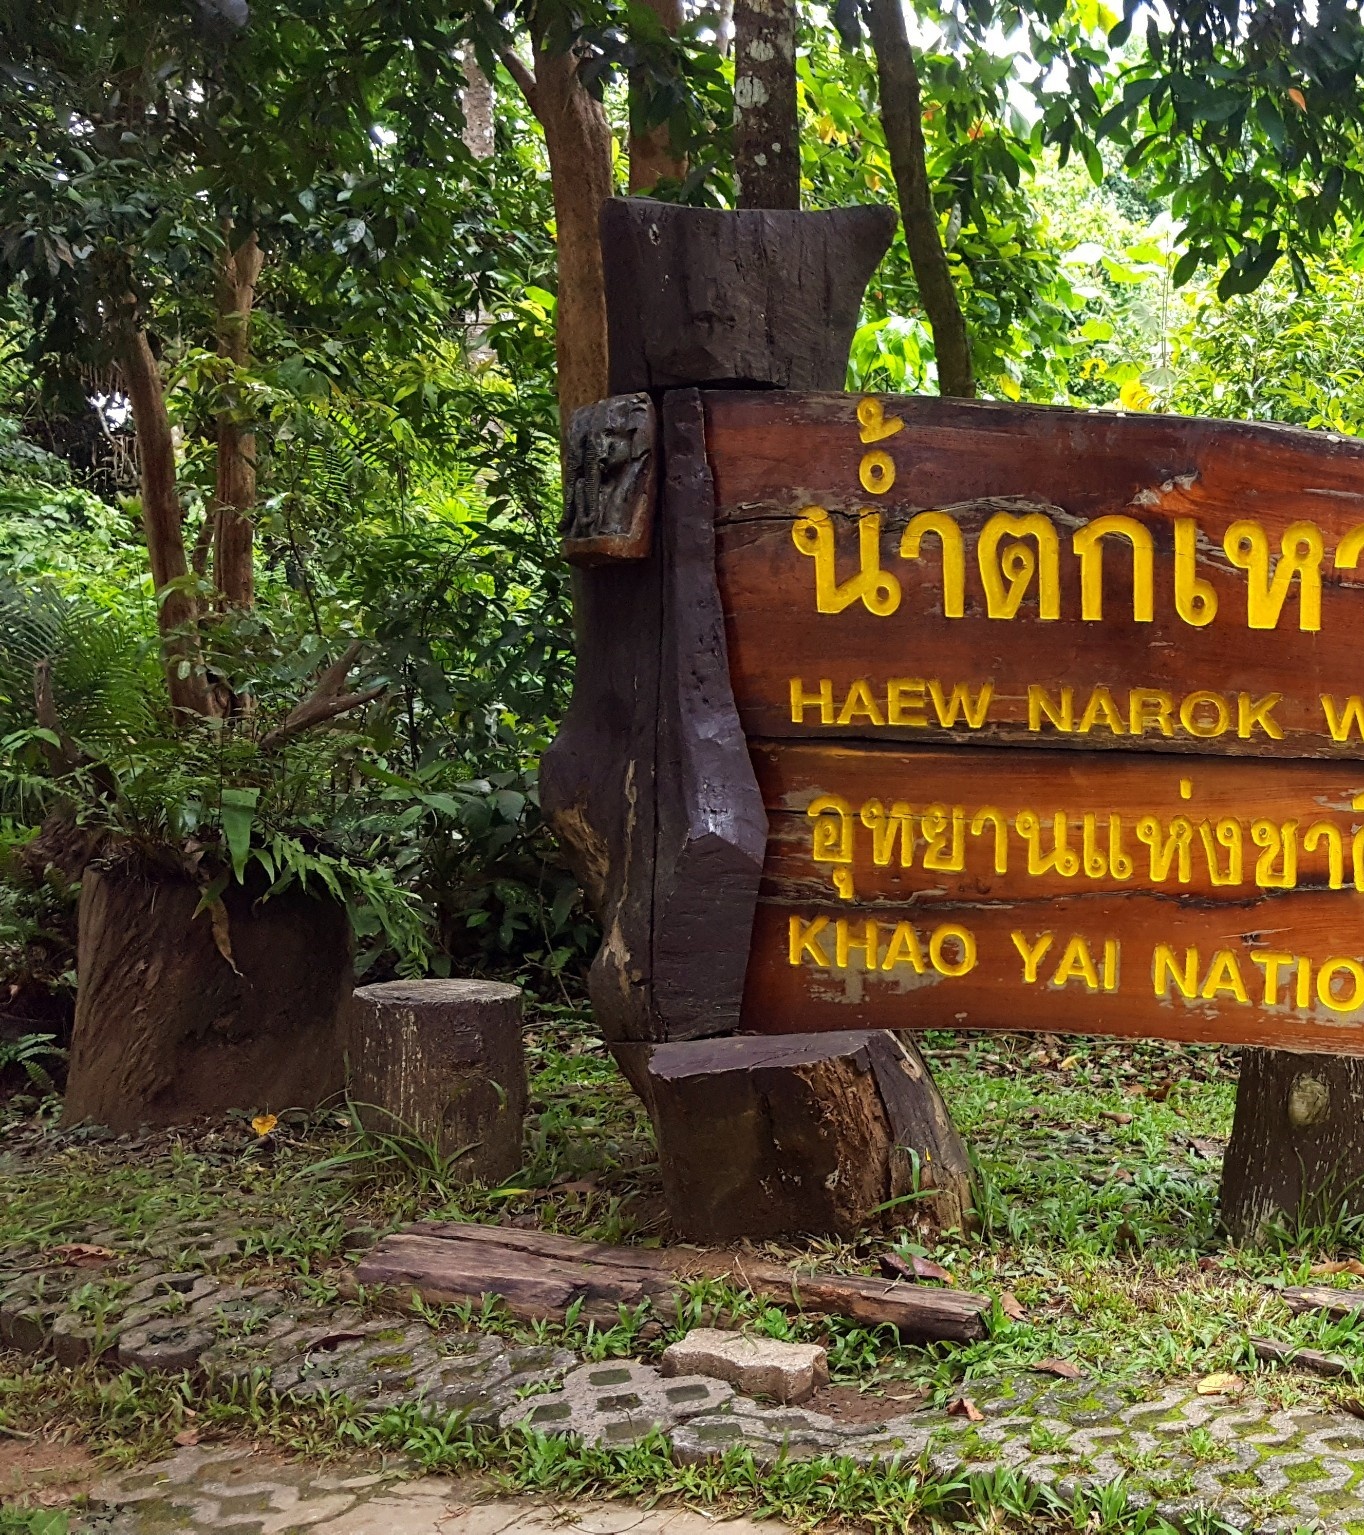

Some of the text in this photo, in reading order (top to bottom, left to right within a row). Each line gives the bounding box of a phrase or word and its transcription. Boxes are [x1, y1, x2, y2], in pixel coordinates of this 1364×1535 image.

[789, 678, 994, 729] HAEW
[1028, 685, 1285, 740] NAROK
[788, 915, 978, 977] KHAO
[1011, 931, 1118, 992] YAI
